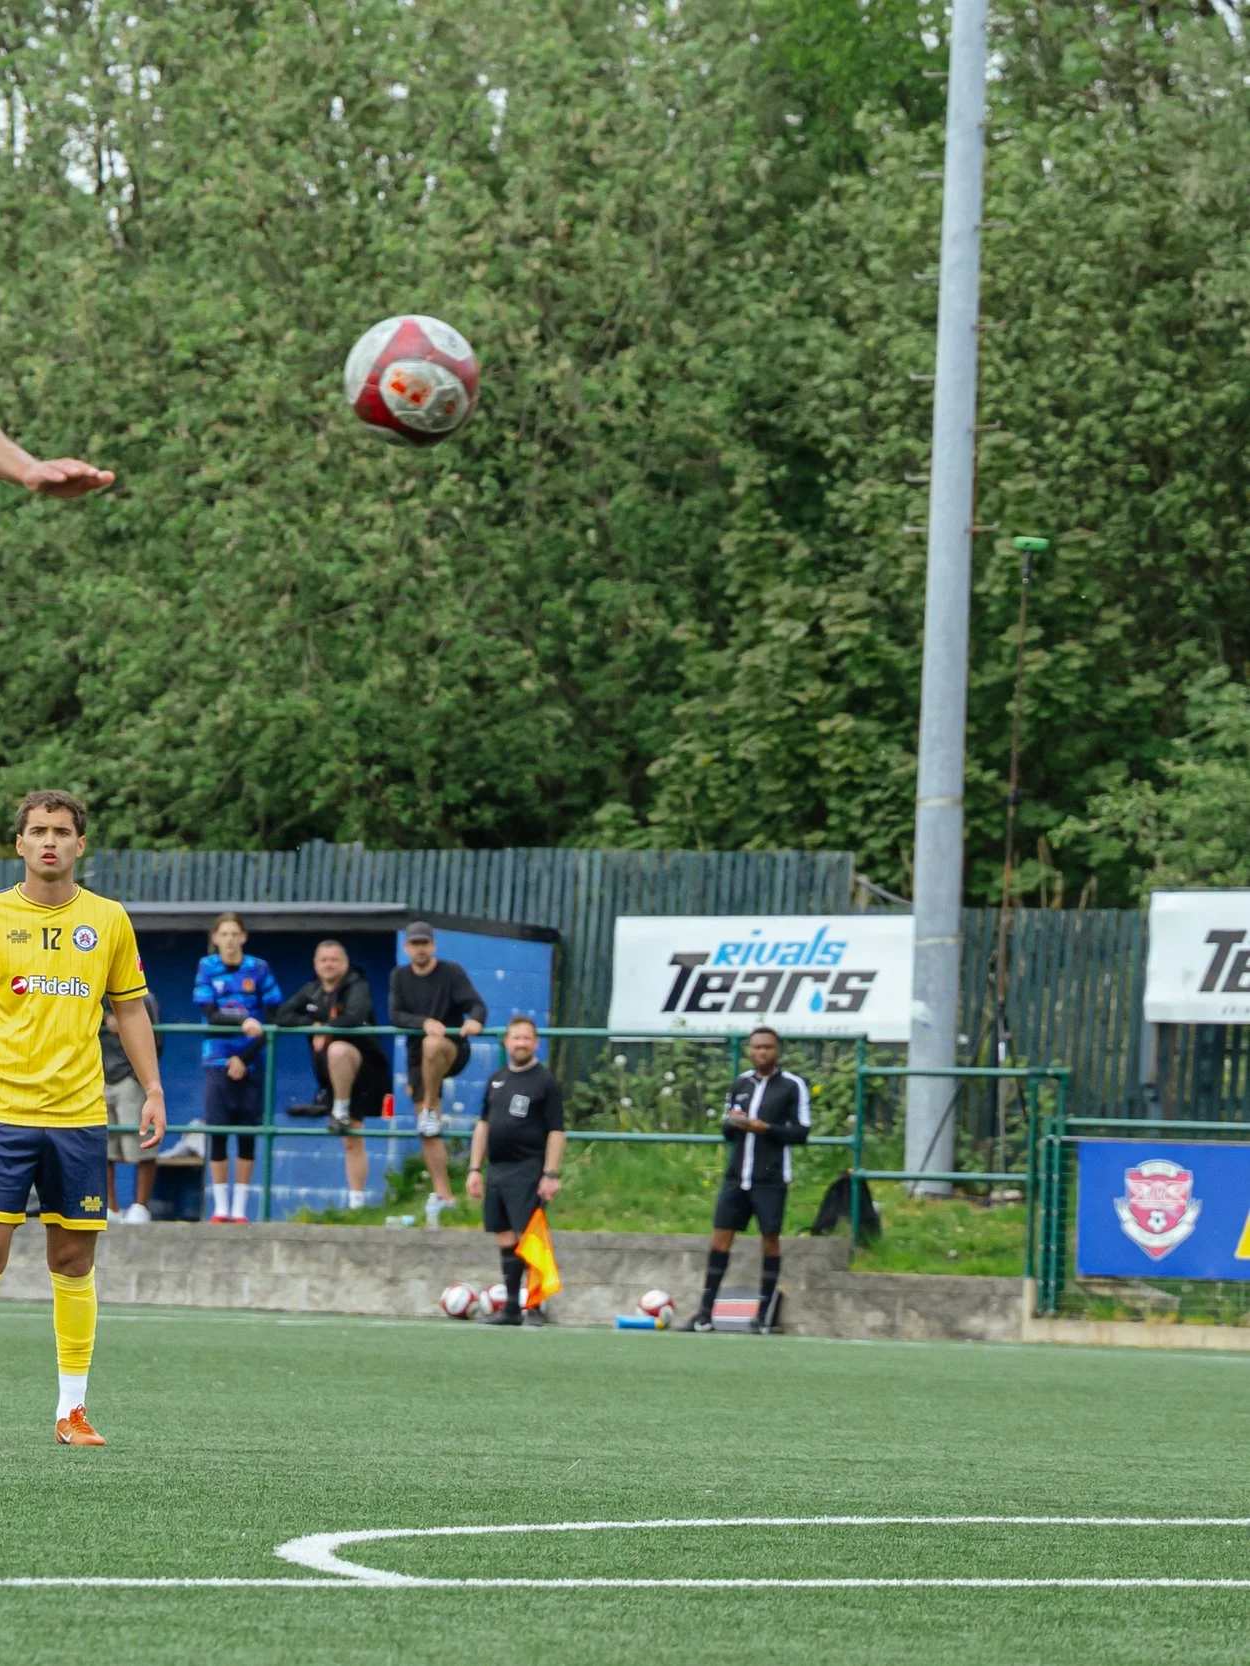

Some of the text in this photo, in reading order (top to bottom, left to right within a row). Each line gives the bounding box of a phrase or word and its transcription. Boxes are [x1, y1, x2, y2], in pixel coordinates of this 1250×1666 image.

[42, 928, 62, 950] 12
[28, 975, 90, 998] Fidelis
[661, 952, 878, 1013] Tears
